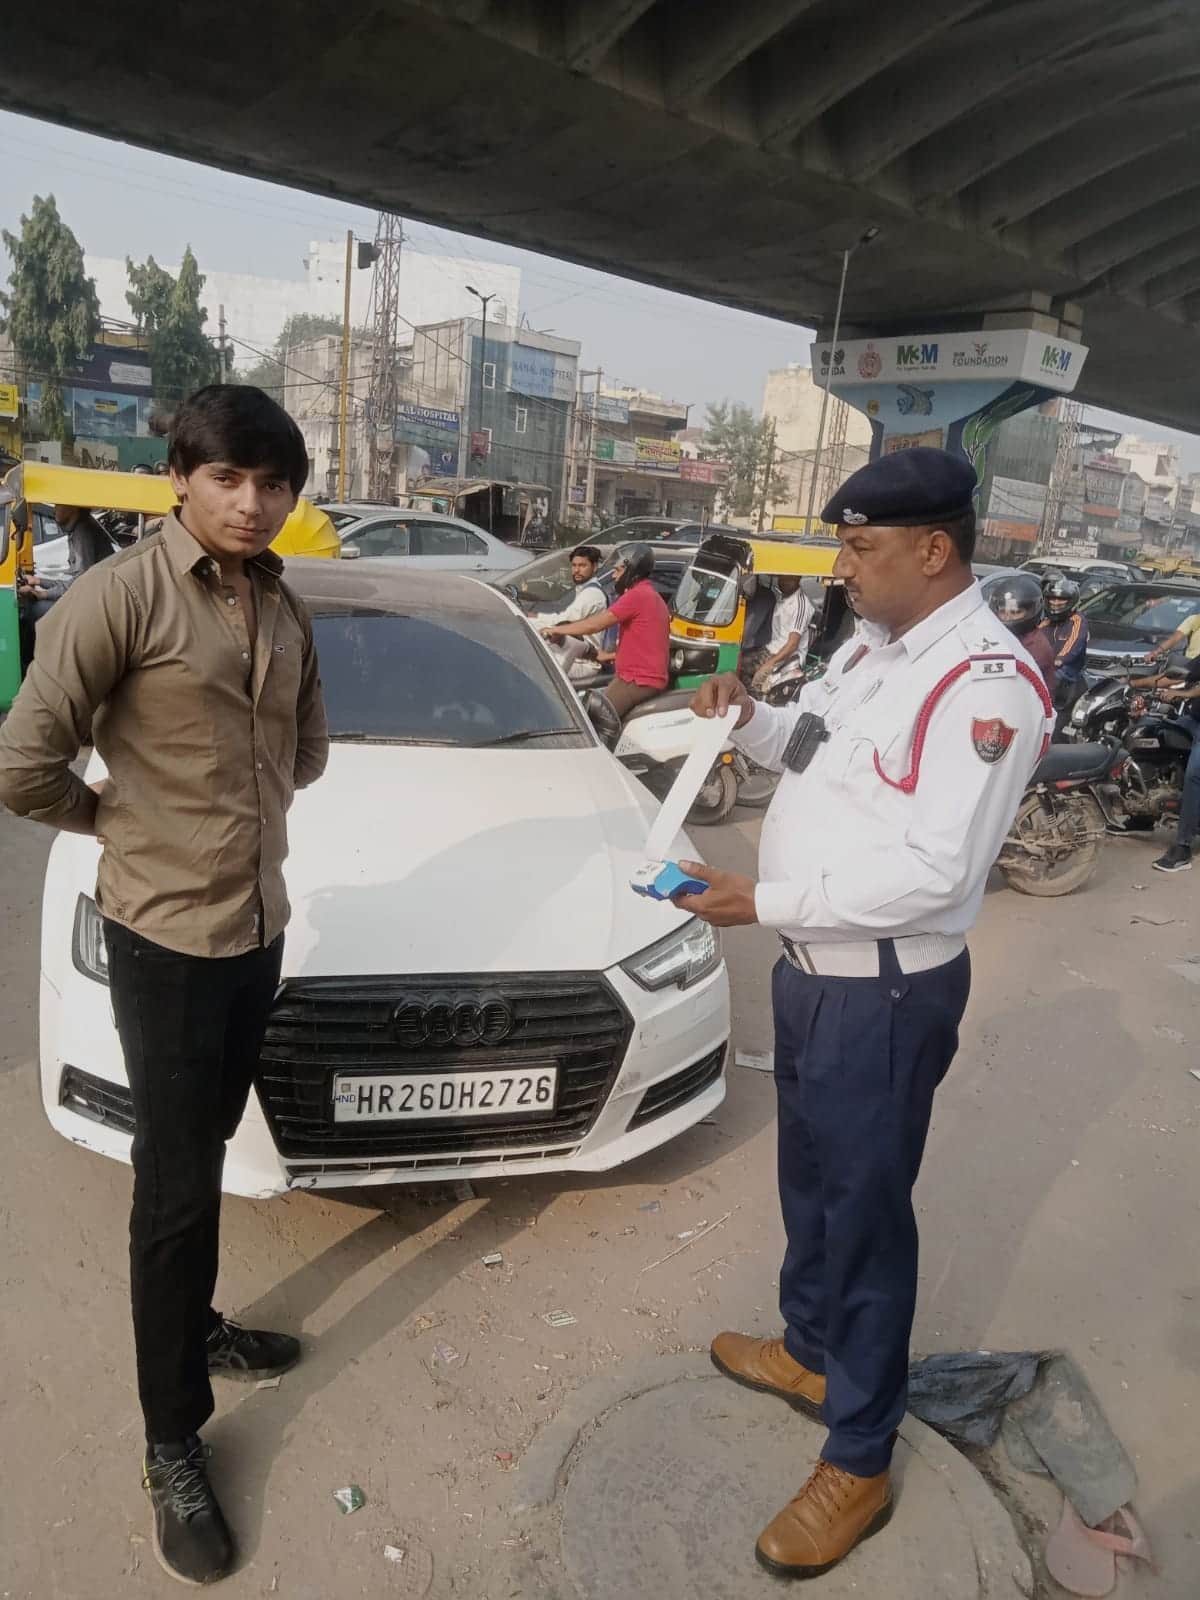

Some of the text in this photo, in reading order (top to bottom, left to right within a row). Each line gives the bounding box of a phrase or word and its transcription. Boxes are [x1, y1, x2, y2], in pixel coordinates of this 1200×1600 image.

[896, 343, 939, 365] M3M
[952, 354, 1009, 367] FOUNDATION
[417, 408, 458, 423] HOSPITAL
[356, 1075, 552, 1115] HR26DH2726
